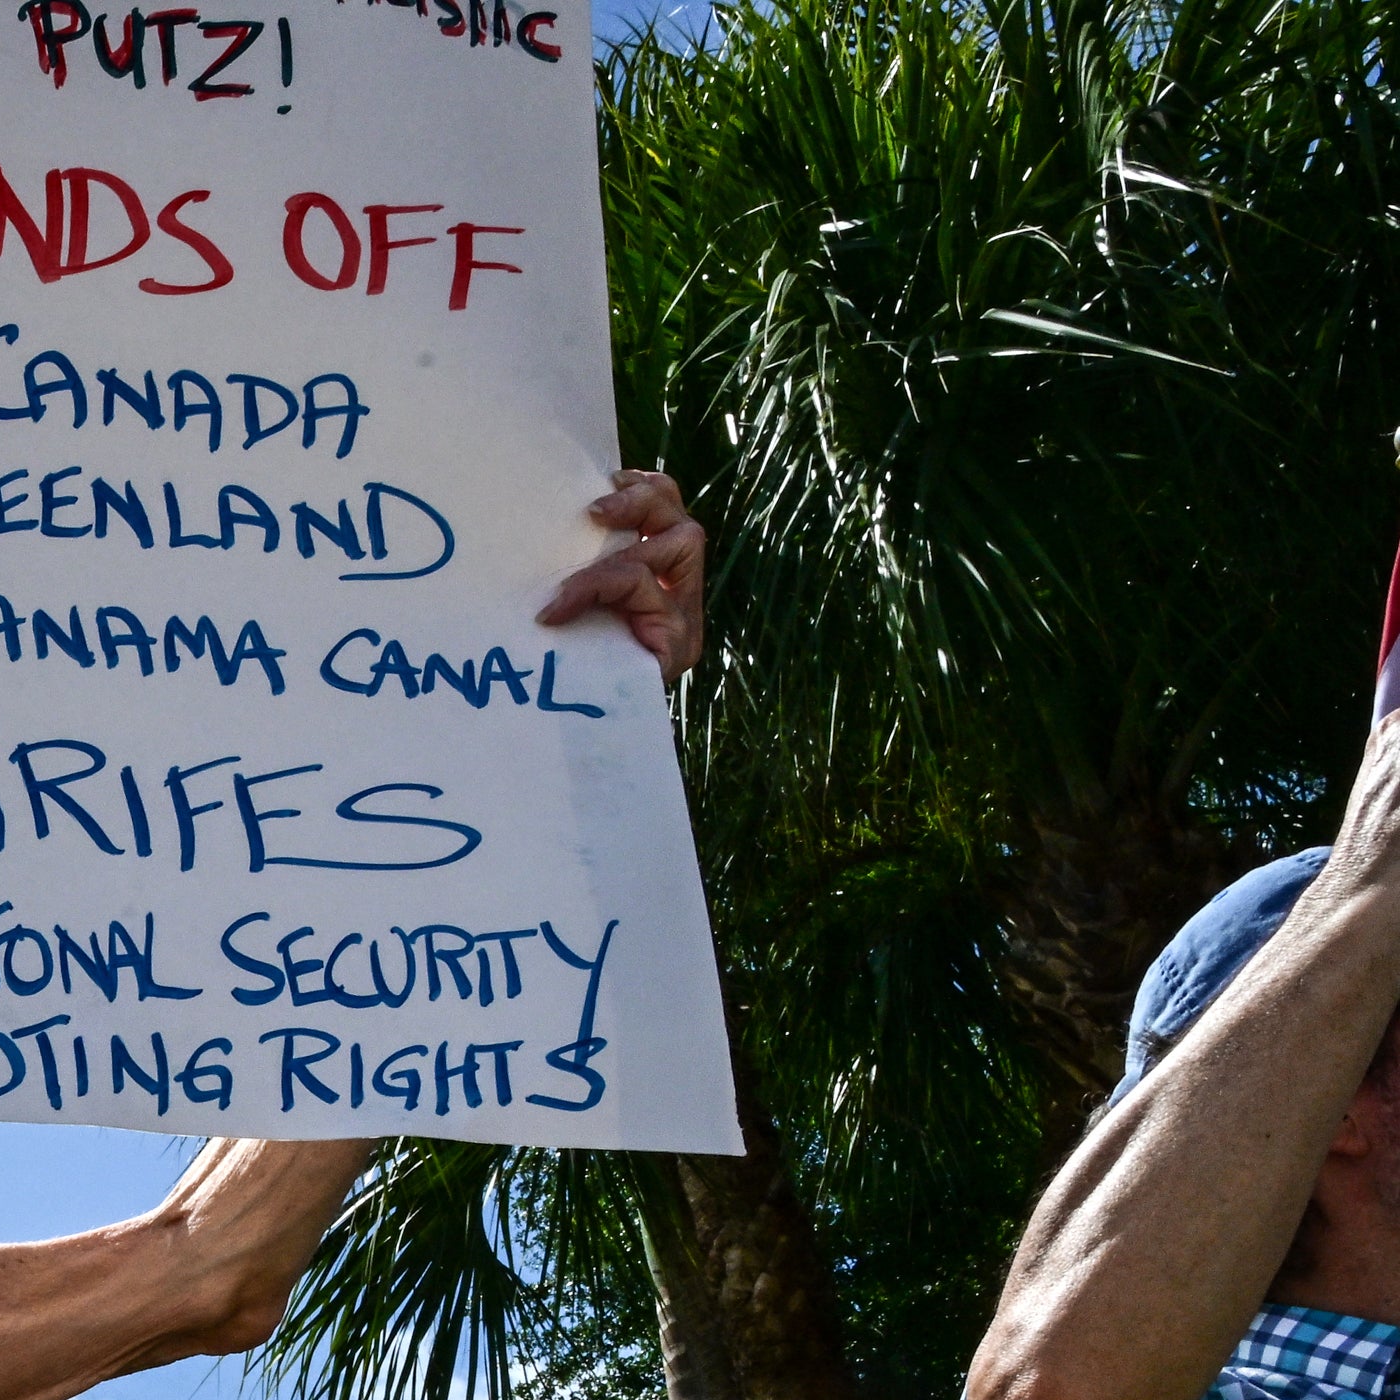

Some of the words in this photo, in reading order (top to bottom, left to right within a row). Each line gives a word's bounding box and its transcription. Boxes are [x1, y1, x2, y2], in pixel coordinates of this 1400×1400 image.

[17, 0, 293, 115] PUTZ!
[283, 192, 522, 310] OFF
[320, 628, 607, 718] CANAL
[220, 912, 620, 1060] SECURITY
[259, 1027, 608, 1116] RIGHTS
